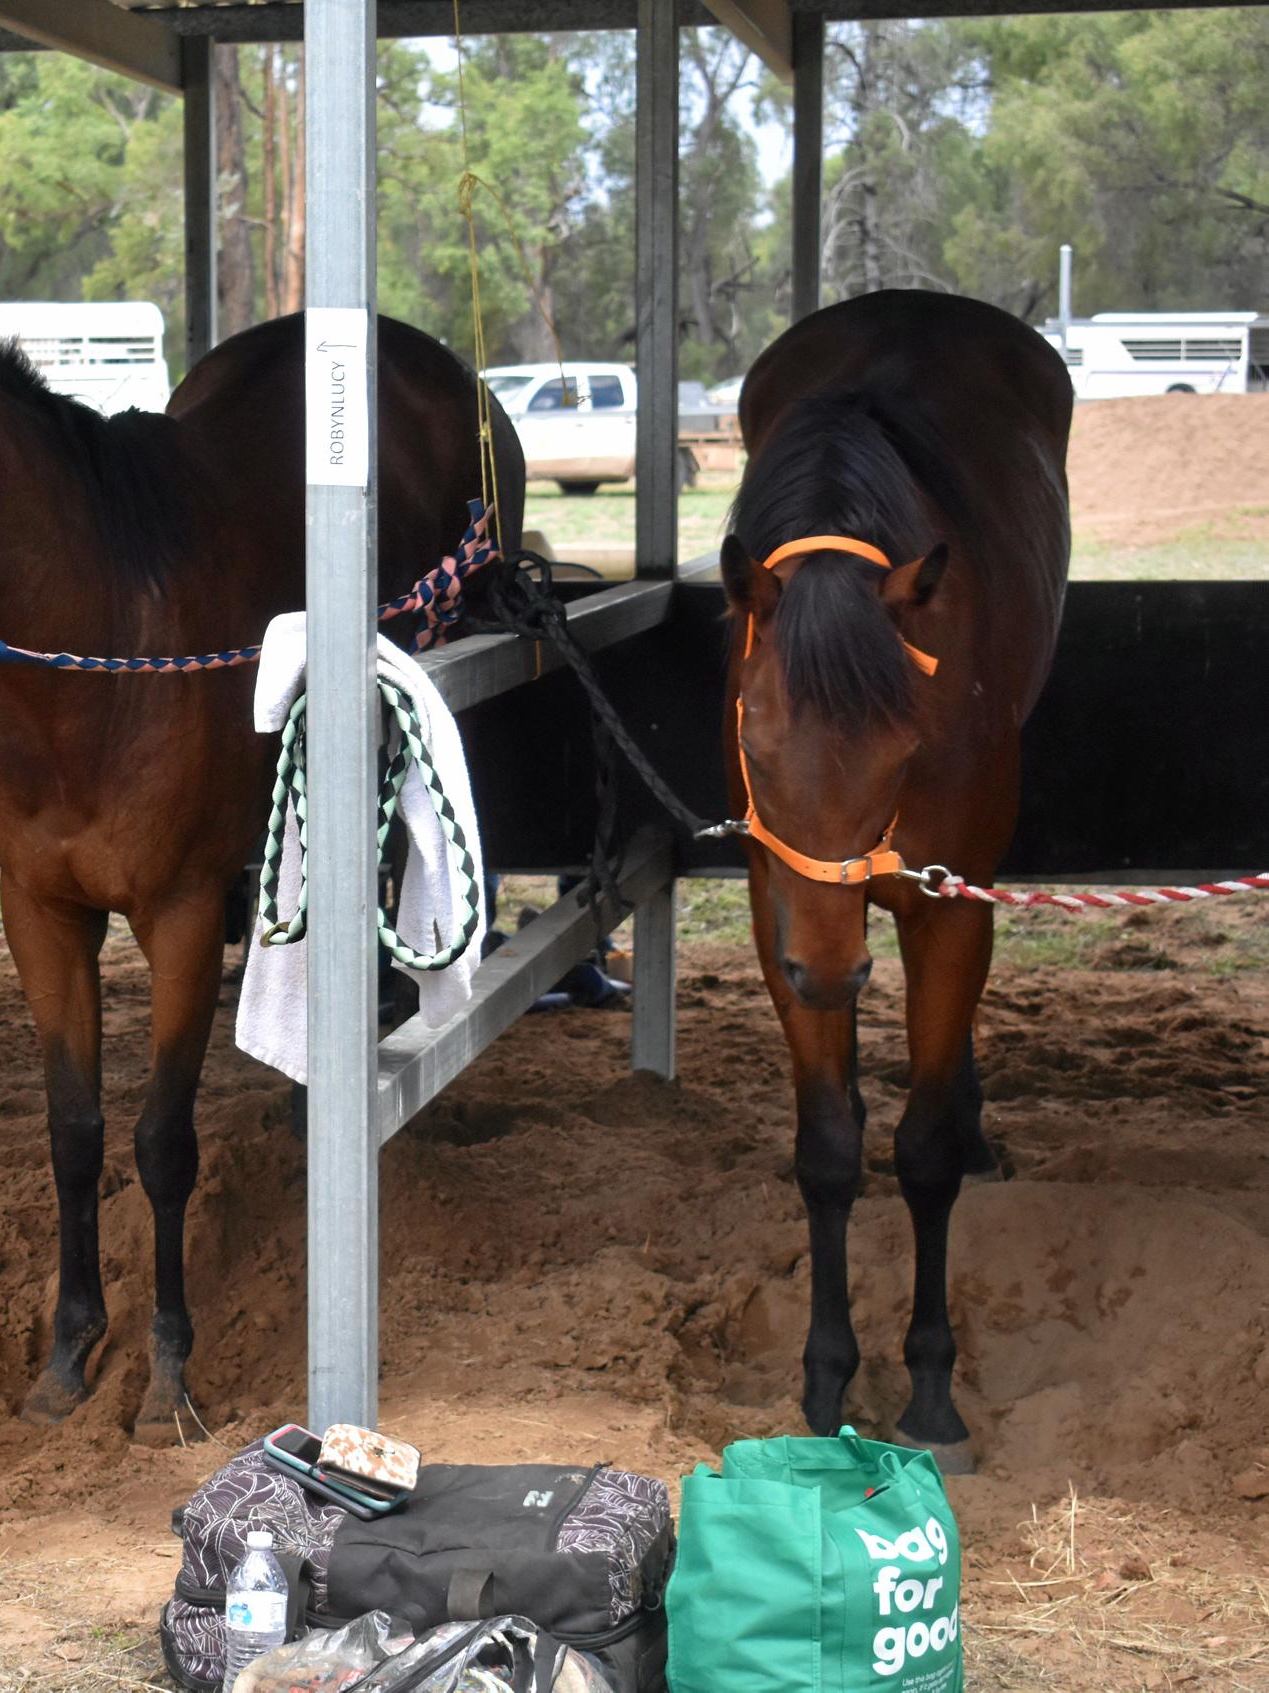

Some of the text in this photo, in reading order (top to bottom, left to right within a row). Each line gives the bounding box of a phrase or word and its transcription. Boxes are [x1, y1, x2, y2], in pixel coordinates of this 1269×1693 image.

[330, 361, 346, 465] ROBYNLUCY
[854, 1517, 948, 1565] bag
[873, 1566, 943, 1616] for
[872, 1600, 958, 1676] good
